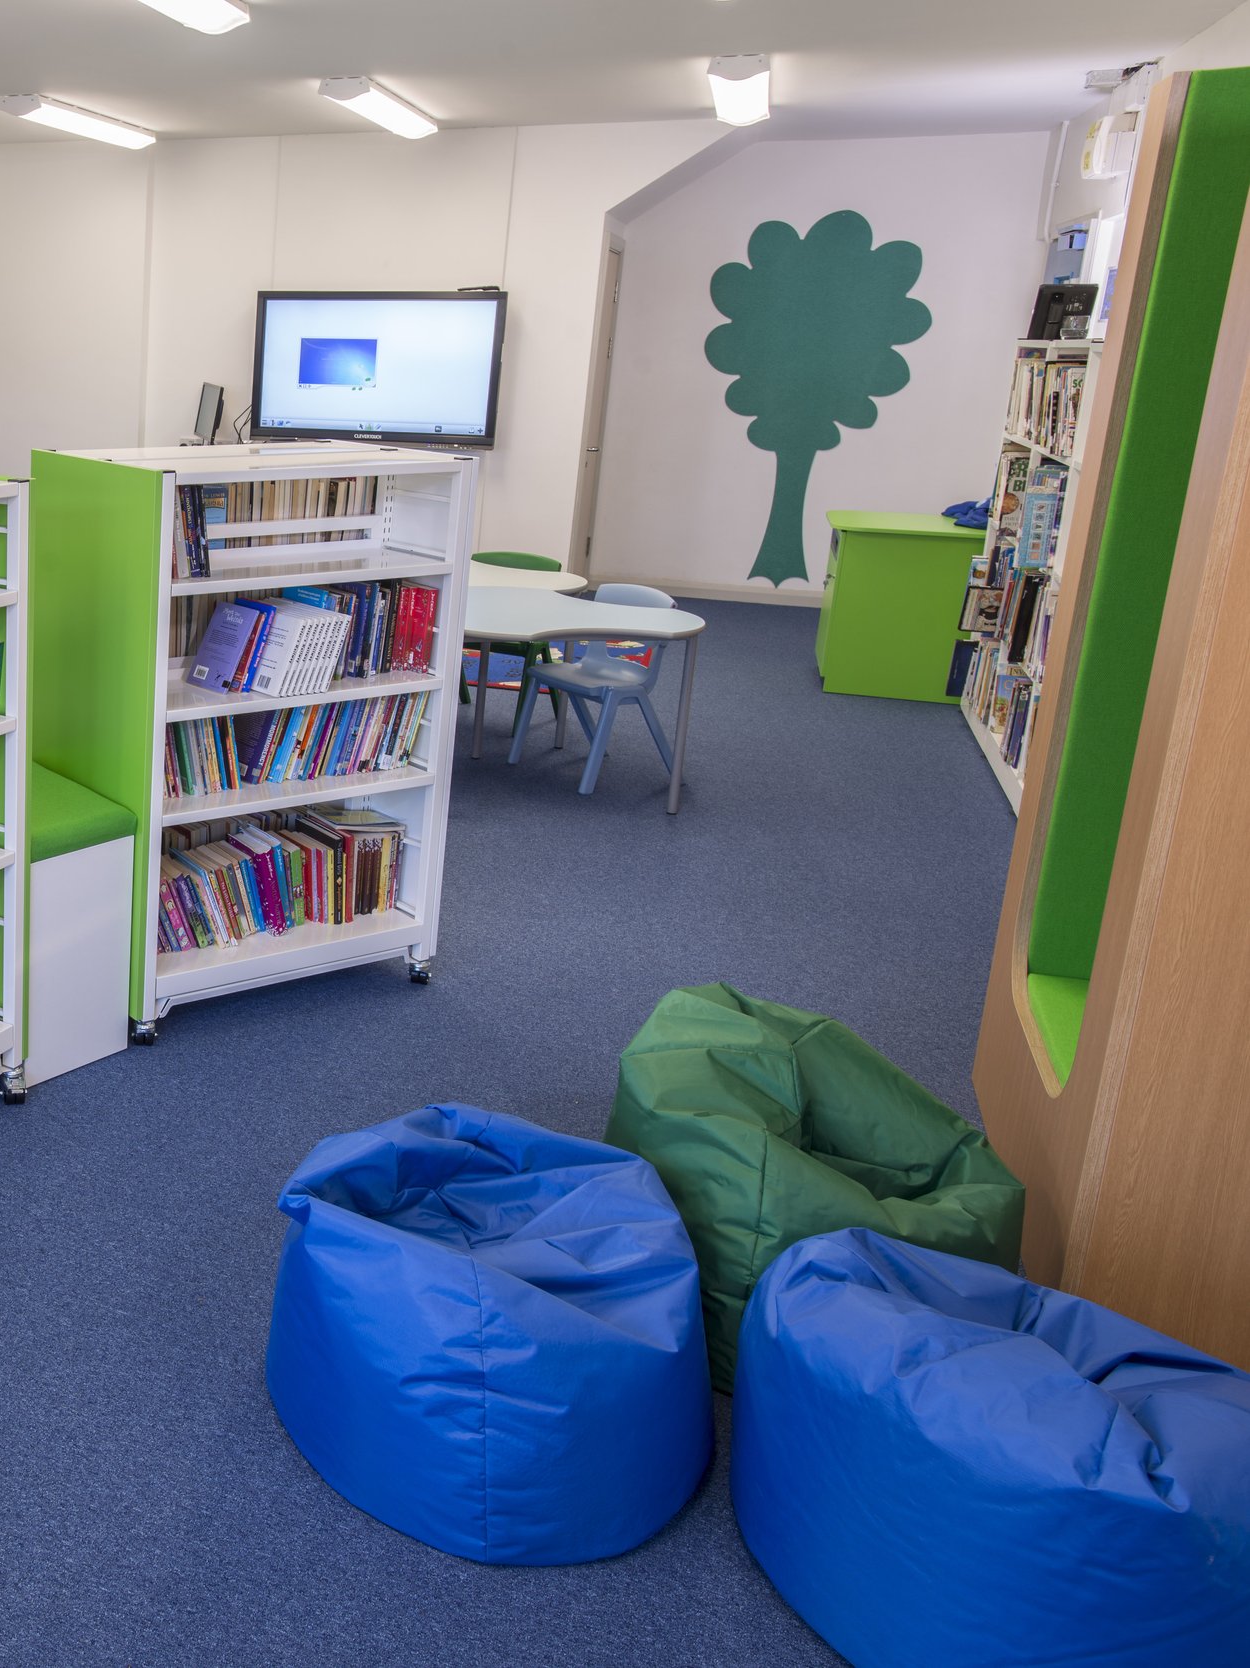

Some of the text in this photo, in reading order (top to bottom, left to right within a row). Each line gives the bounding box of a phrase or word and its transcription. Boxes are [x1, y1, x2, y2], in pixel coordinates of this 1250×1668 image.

[289, 626, 305, 663] Peter's Railway
[296, 625, 312, 662] Peter's Railway
[302, 624, 318, 662] Peter's Railway
[309, 623, 324, 661] Peter's Railway
[316, 622, 331, 660] Peter's Railway
[322, 621, 338, 659] Peter's Railway
[328, 640, 337, 659] Railway
[259, 724, 276, 766] MONTMORENCY
